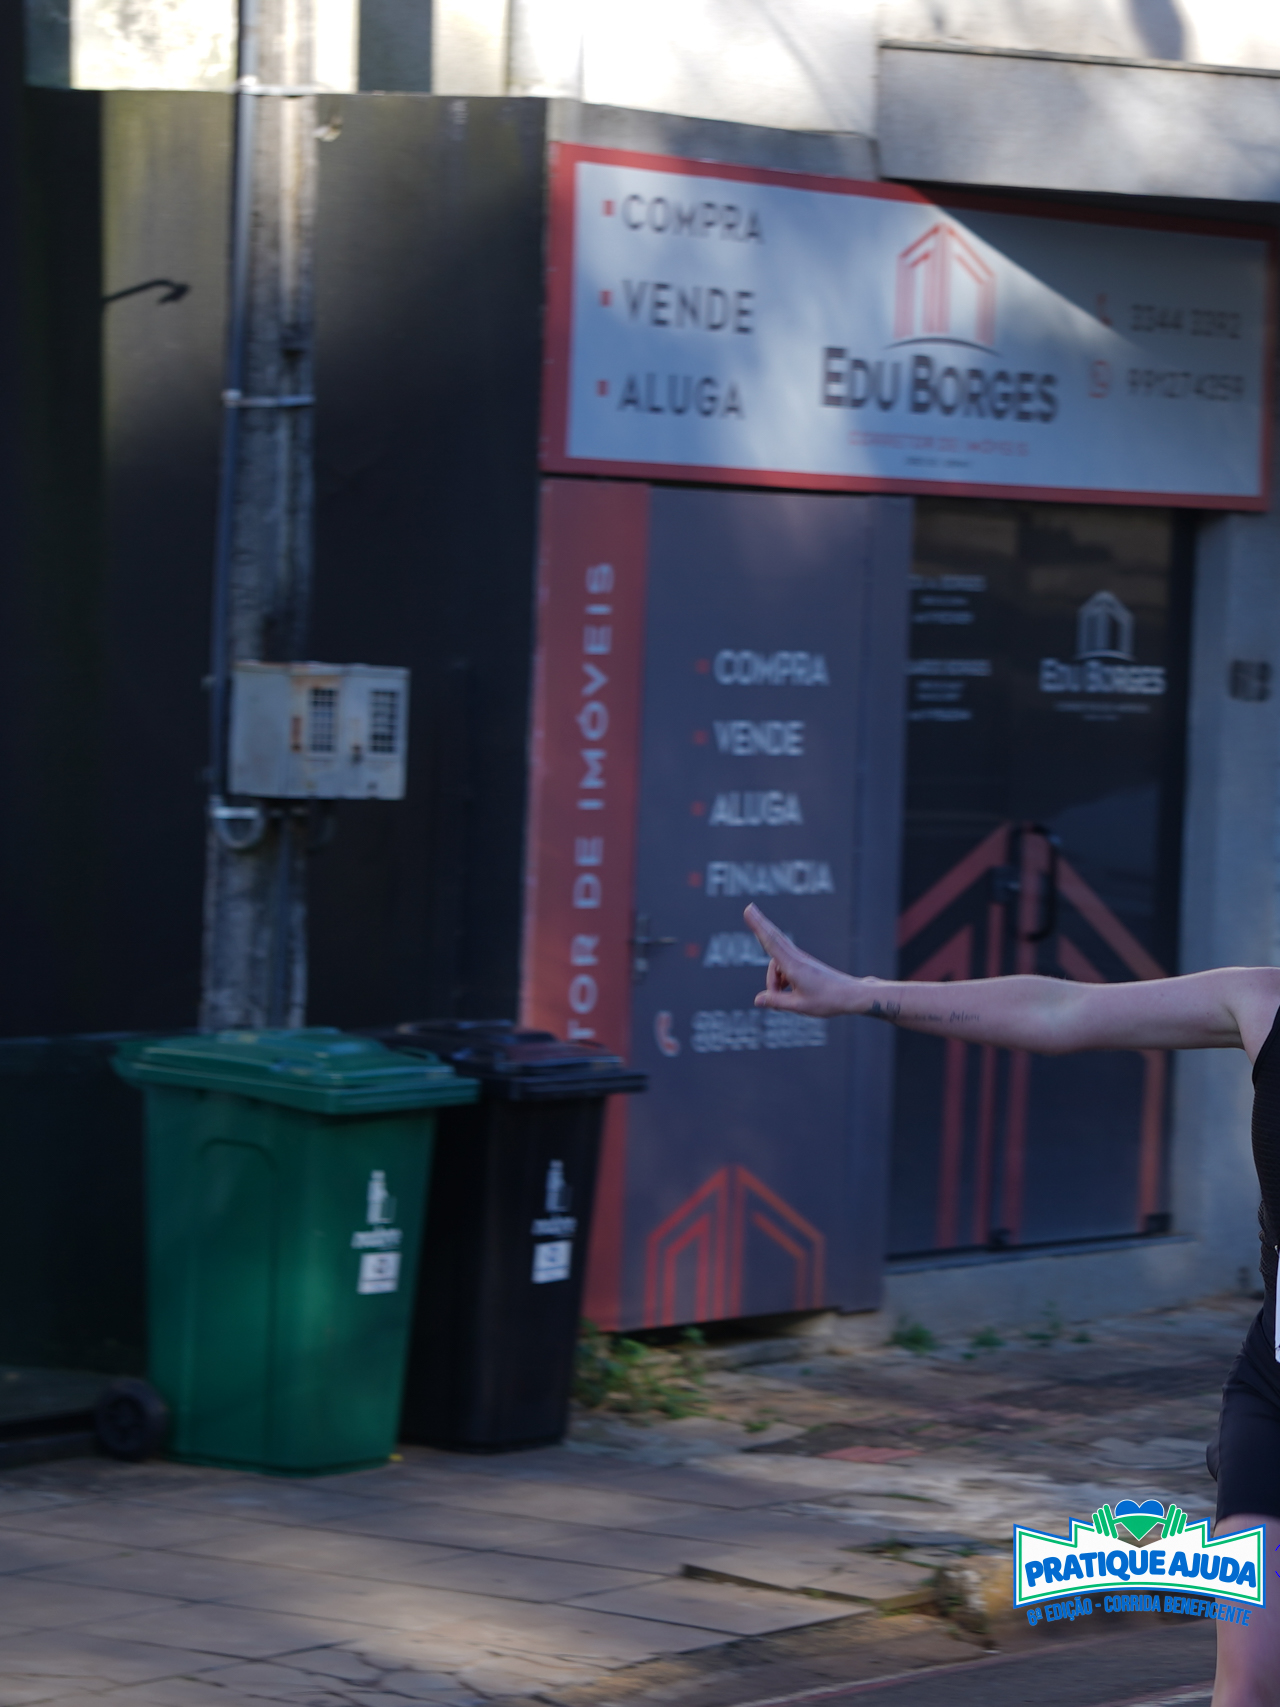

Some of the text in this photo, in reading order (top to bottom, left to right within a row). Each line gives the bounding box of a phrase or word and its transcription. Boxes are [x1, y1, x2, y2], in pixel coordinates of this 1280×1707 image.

[621, 194, 764, 244] COMPRA
[622, 279, 754, 334] VENDE
[617, 372, 746, 420] ALUGA
[909, 354, 1059, 424] BORGES
[575, 562, 615, 811] IMÓVEIS
[713, 649, 829, 687] COMPRA
[713, 720, 805, 757] VENDE
[709, 790, 803, 827] ALUGA
[573, 836, 604, 908] DE
[706, 860, 835, 897] FINANCIA
